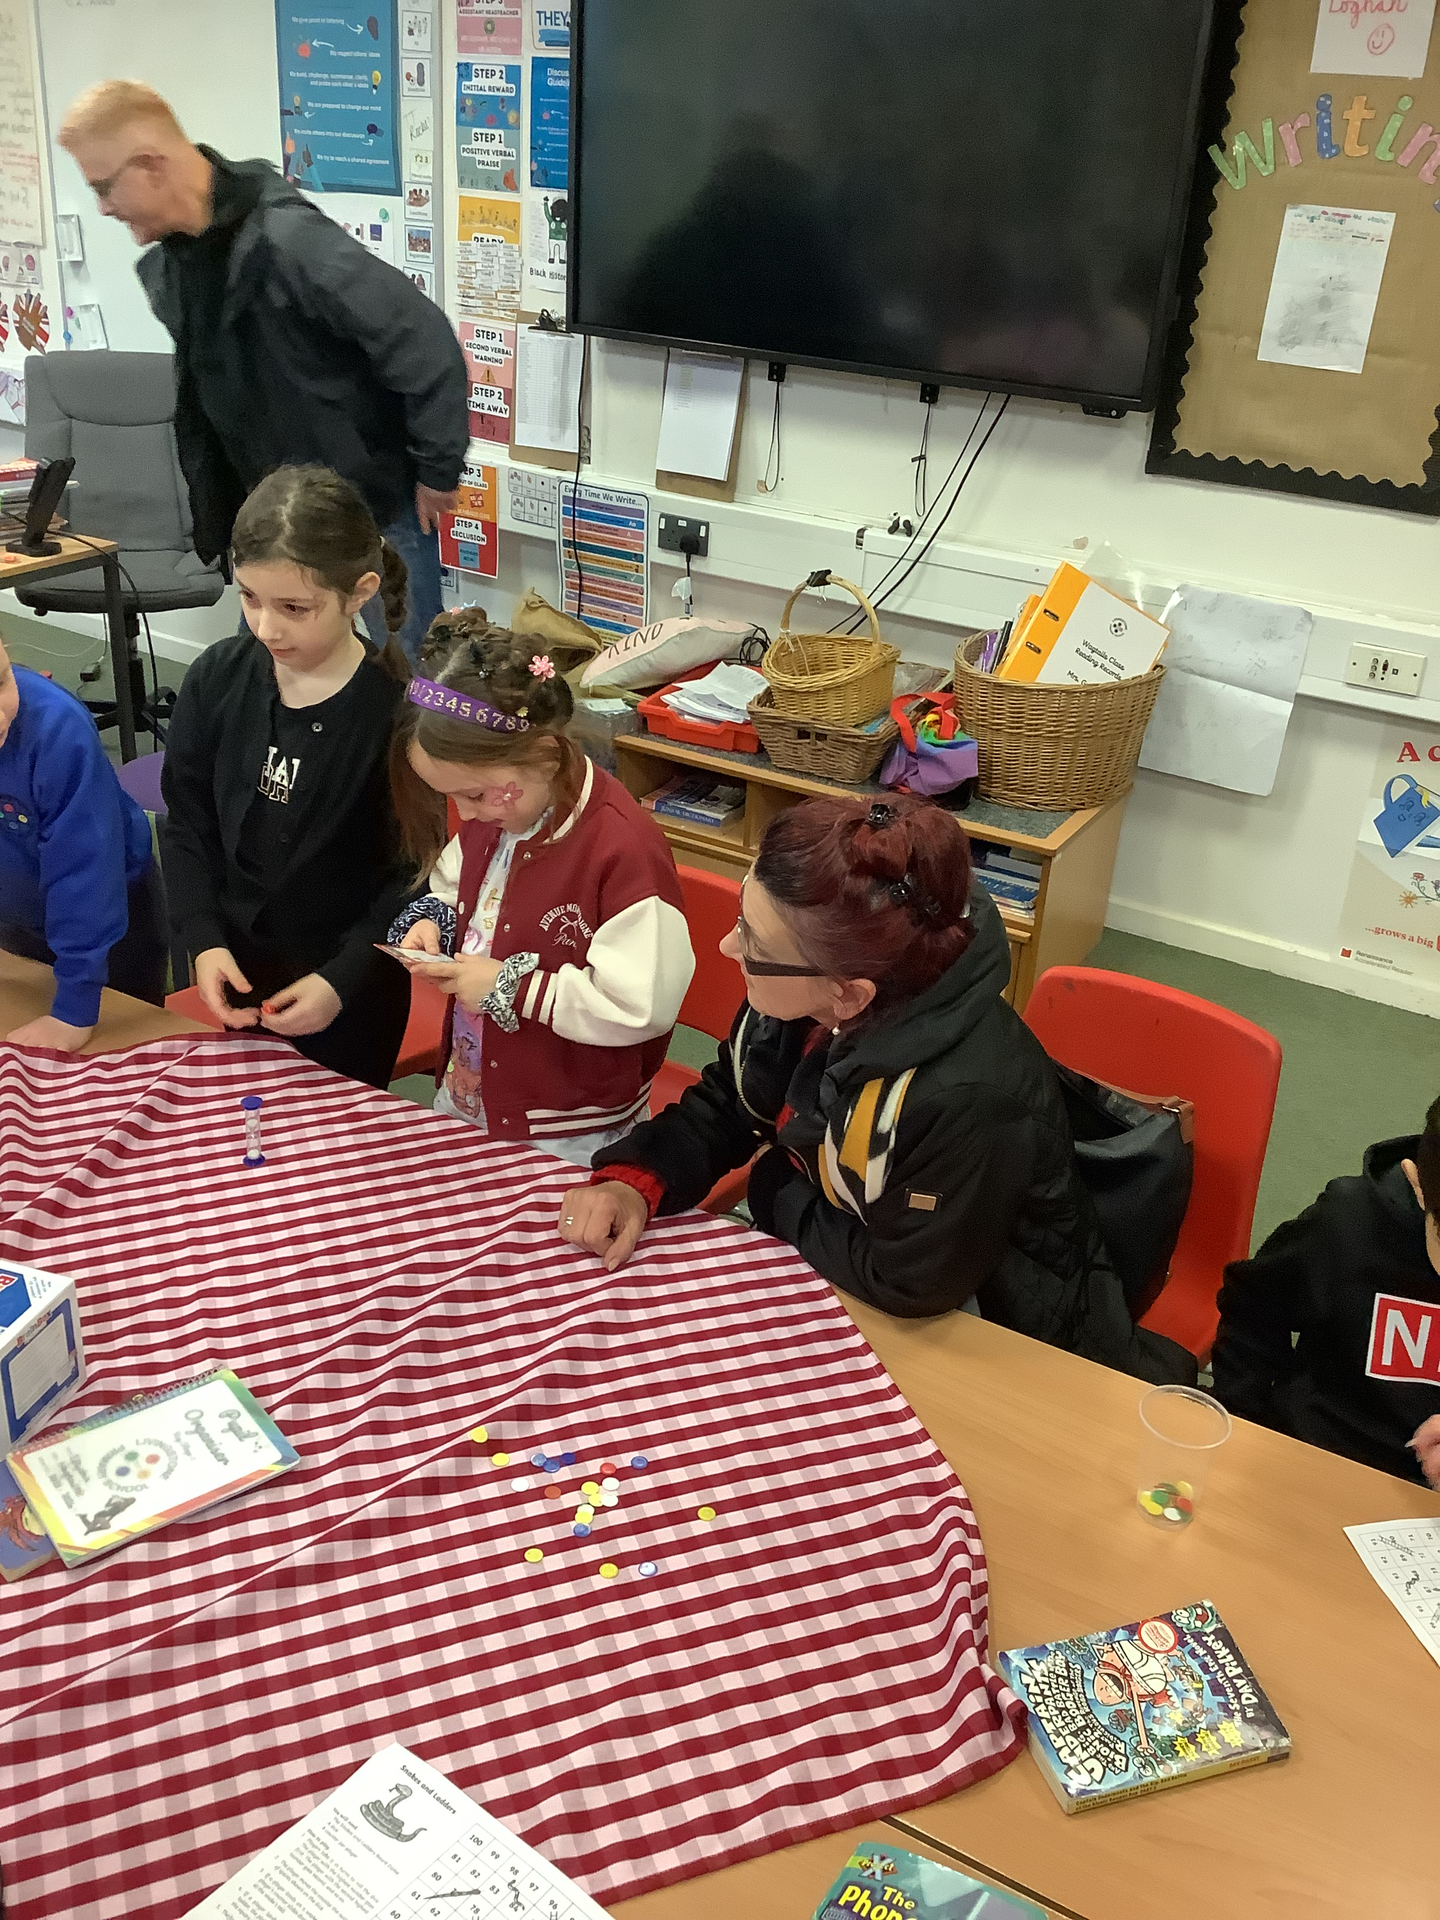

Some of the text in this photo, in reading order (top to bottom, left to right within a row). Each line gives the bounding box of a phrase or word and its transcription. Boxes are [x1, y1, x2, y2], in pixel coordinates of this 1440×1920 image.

[474, 69, 496, 79] STEP
[499, 70, 504, 80] 2
[547, 68, 569, 76] Discus
[463, 84, 514, 93] INITIAL REWARD
[473, 132, 502, 143] STEP 1
[462, 147, 490, 156] POSITIVE
[476, 329, 503, 342] STEP 1
[466, 342, 512, 356] SECOND VERBAL
[474, 354, 502, 364] WARNING
[474, 387, 502, 400] STEP 2
[468, 400, 508, 414] TIME AWAY
[477, 469, 481, 477] 3
[584, 489, 600, 499] Time
[602, 492, 613, 501] We
[456, 520, 472, 528] STEP
[452, 530, 485, 543] SECLUSION
[1082, 639, 1124, 671] Wagtails Class
[1075, 647, 1121, 680] Reading Records
[1397, 742, 1421, 762] A
[539, 905, 565, 932] AVENUE
[1417, 936, 1433, 949] big
[1356, 950, 1393, 964] Renaissance
[1354, 957, 1414, 976] Accelerated Reader
[1232, 1677, 1258, 1708] DAV
[1058, 1675, 1086, 1728] BOOGER
[1244, 1706, 1255, 1719] BY
[1060, 1710, 1077, 1732] BAD
[400, 1765, 456, 1814] Snakes and Ladders
[1076, 1797, 1096, 1805] Captain
[1099, 1789, 1128, 1801] Underpants
[451, 1854, 461, 1863] 81
[470, 1869, 480, 1878] 82
[489, 1885, 500, 1895] 83
[469, 1834, 558, 1910] 100 99 98 97 96
[432, 1872, 480, 1914] 80 78
[884, 1886, 915, 1910] The
[411, 1891, 440, 1917] 61 62
[390, 1910, 400, 1920] 60
